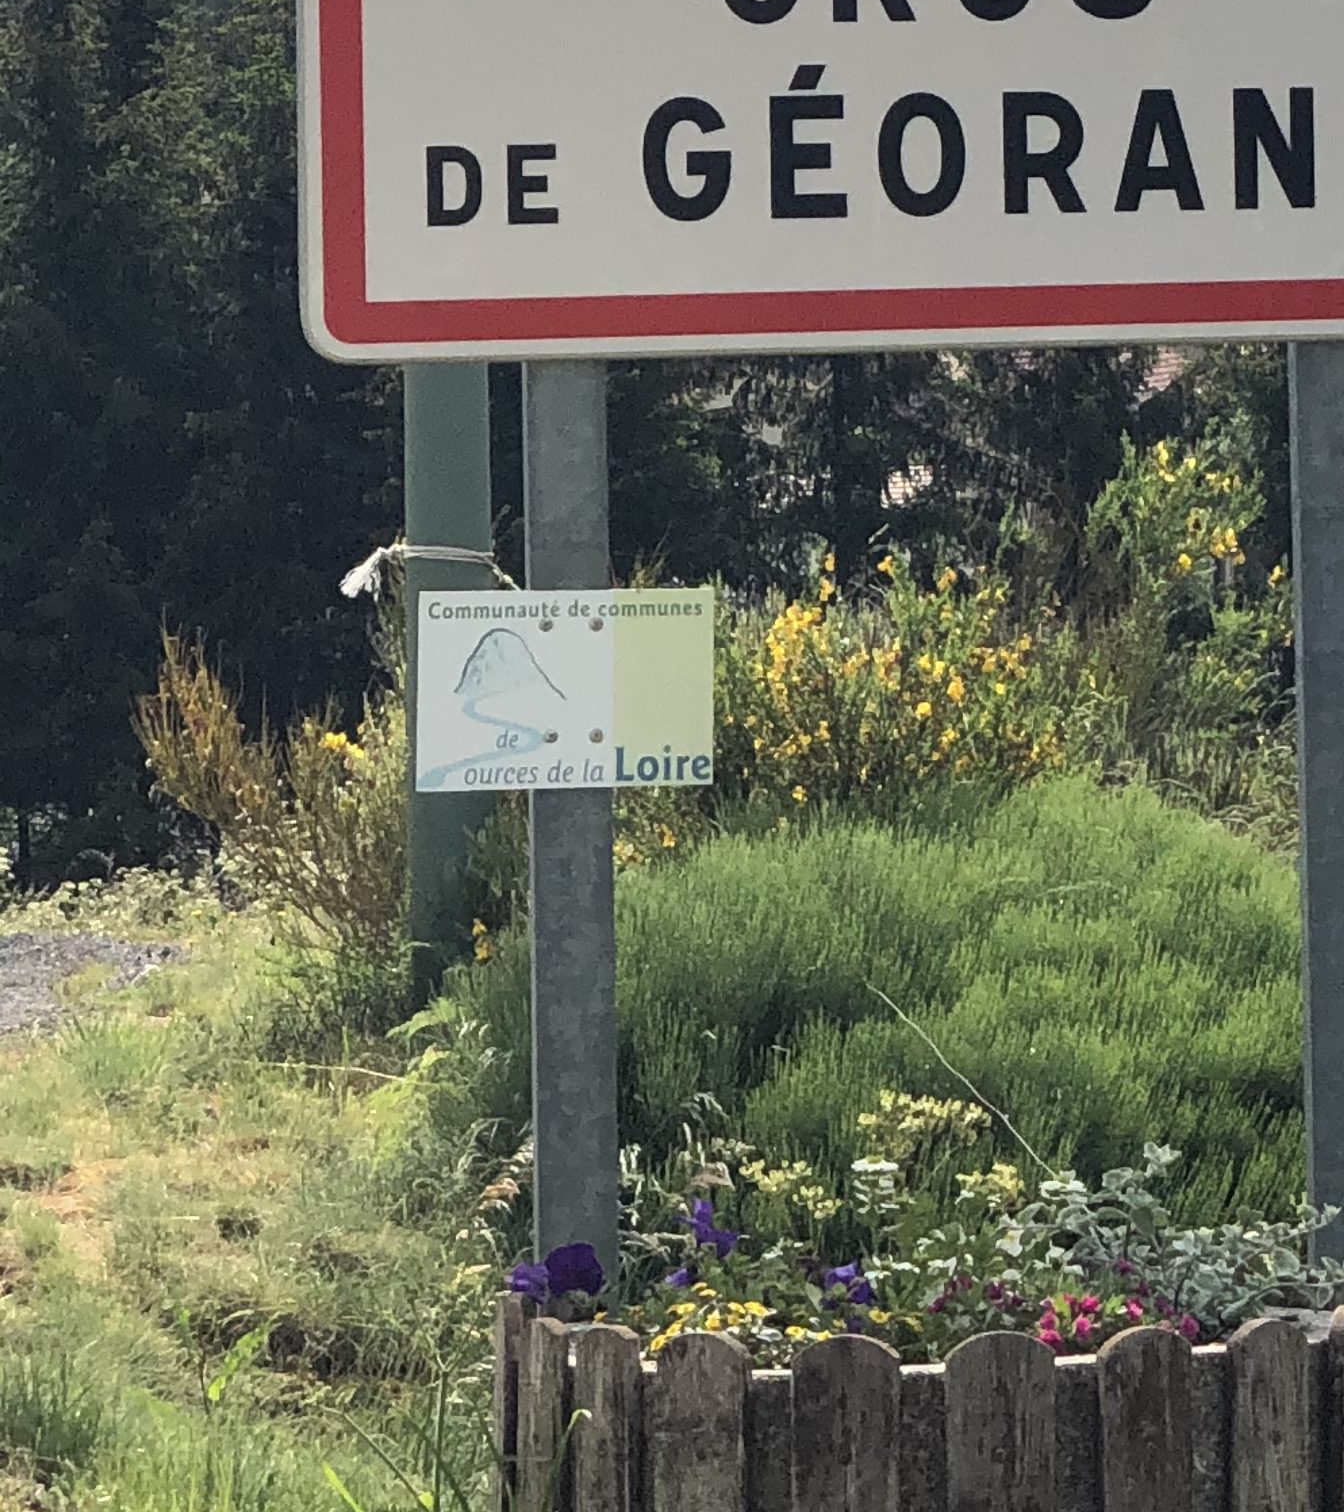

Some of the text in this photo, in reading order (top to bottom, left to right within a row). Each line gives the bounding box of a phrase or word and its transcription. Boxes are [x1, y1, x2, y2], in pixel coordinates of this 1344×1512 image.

[426, 144, 559, 227] DE
[428, 600, 703, 620] Communauté de communes
[495, 730, 519, 749] de
[549, 760, 574, 783] de
[582, 759, 604, 782] la
[615, 745, 712, 782] Loire
